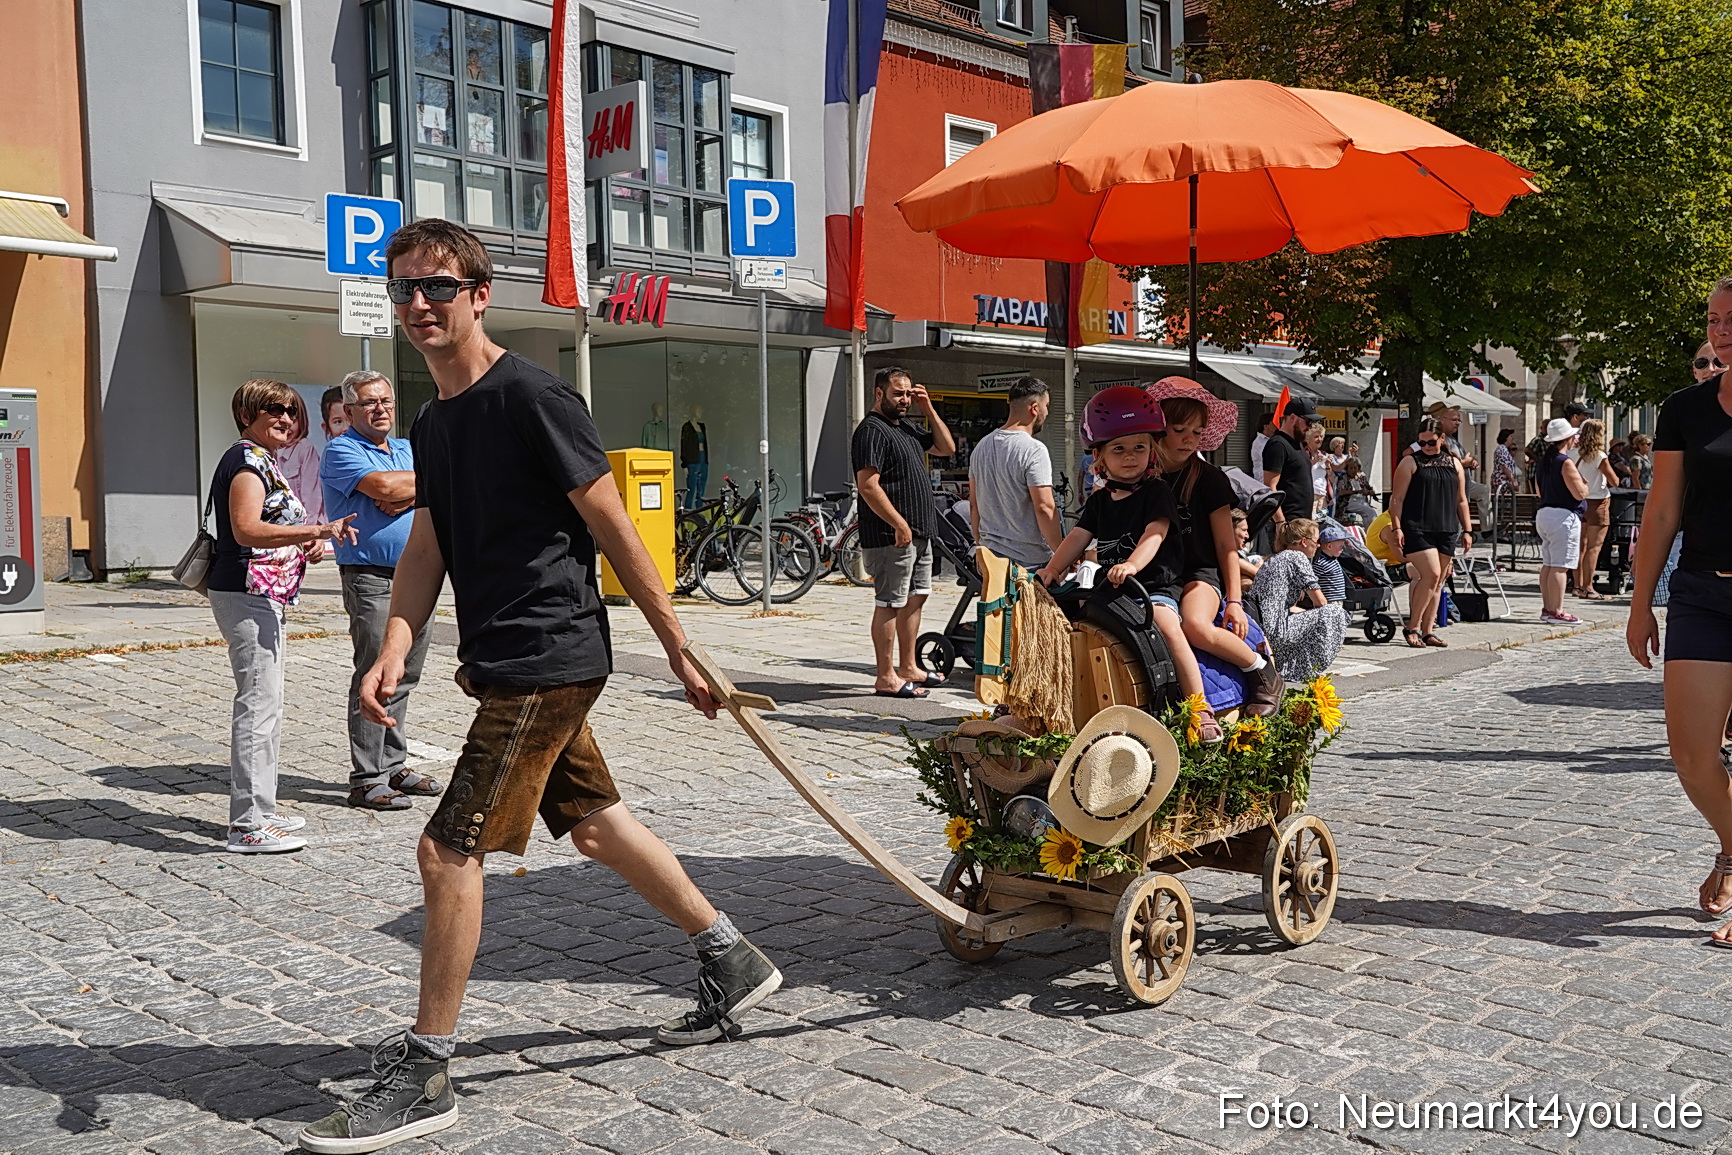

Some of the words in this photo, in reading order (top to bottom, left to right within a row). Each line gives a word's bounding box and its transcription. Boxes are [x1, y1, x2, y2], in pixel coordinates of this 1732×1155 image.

[587, 101, 634, 159] H&M
[344, 205, 385, 265] P
[745, 189, 780, 247] P
[346, 289, 388, 301] Elektrofahrzeuge
[351, 300, 373, 308] während
[604, 272, 670, 328] H&M
[349, 310, 384, 320] Ladevorgangs
[980, 378, 996, 389] NZ
[3, 457, 15, 532] Elektrofahrzeuge
[5, 535, 15, 548] für
